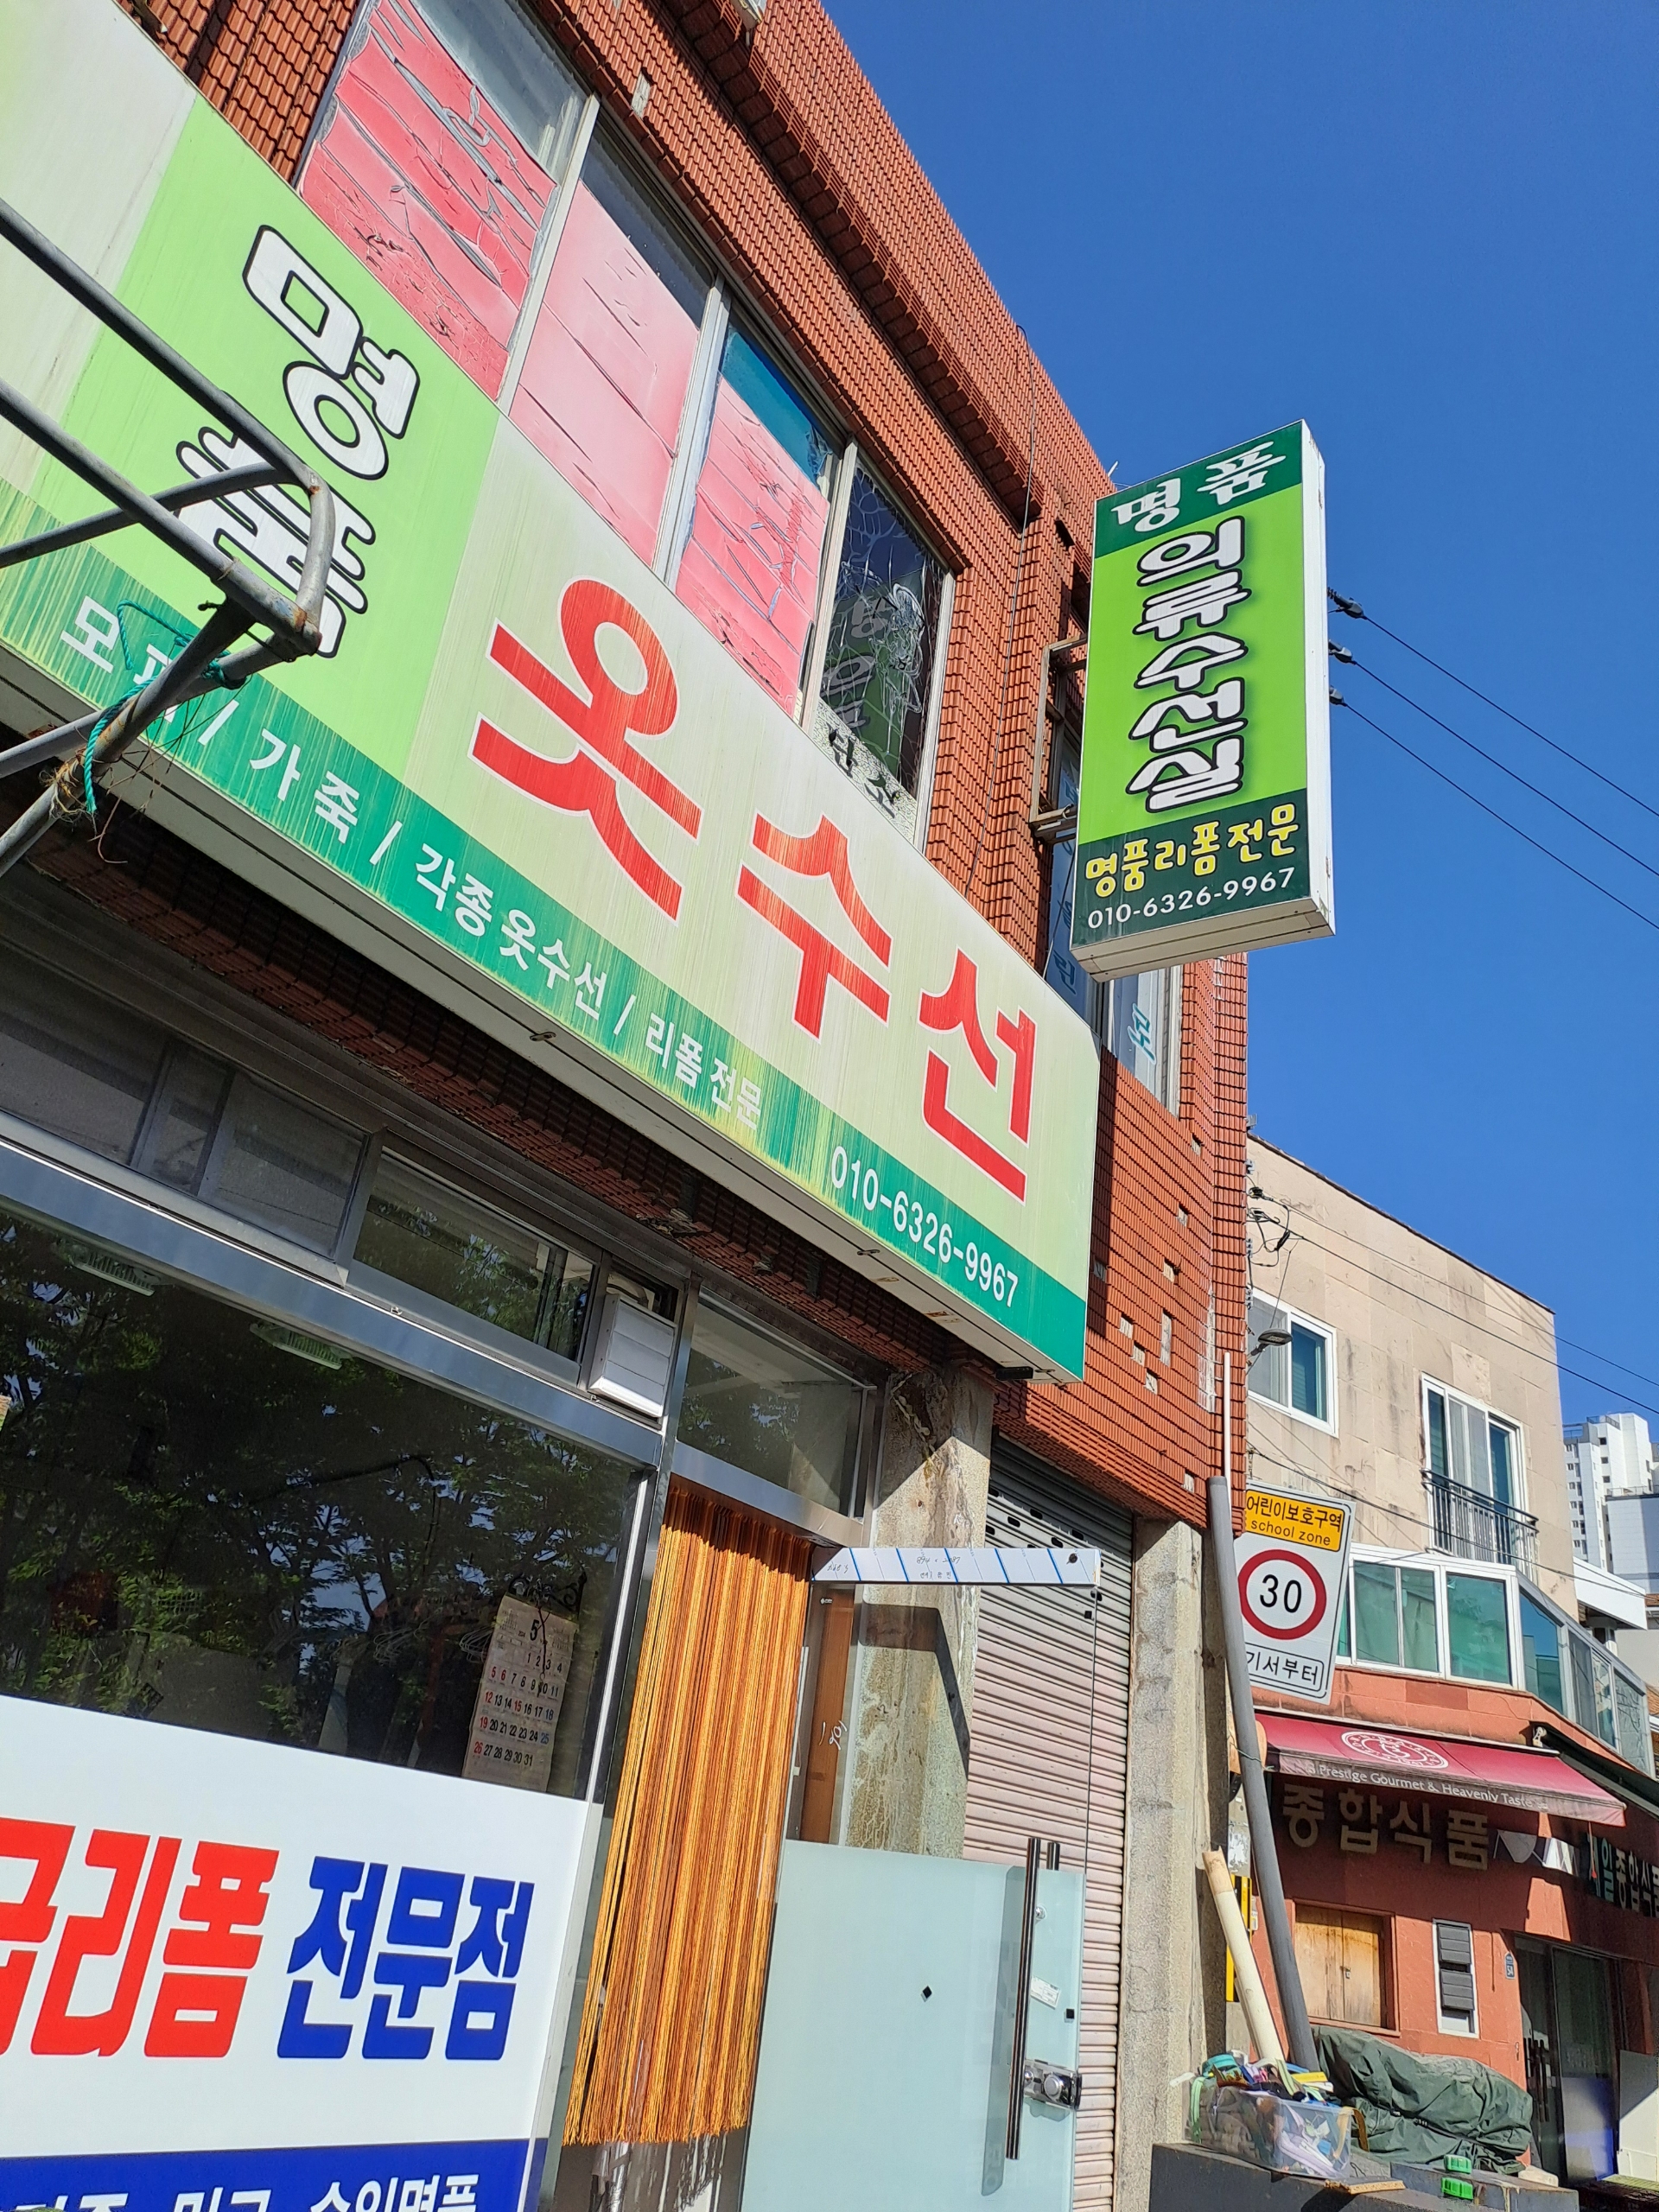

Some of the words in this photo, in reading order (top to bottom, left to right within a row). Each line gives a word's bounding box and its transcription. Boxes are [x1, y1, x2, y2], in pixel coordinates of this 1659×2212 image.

[1125, 514, 1252, 815] 의류수선실
[1087, 867, 1296, 930] 010-6326-9967
[830, 1145, 1020, 1308] 010-6326-9967
[1246, 1495, 1342, 1533] 어린이보호구역
[1250, 1519, 1295, 1538] school
[1299, 1530, 1332, 1546] zone
[1259, 1573, 1302, 1614] 30
[1319, 1764, 1368, 1783] Prestige
[1370, 1772, 1425, 1792] Gourmet
[1442, 1783, 1498, 1803] Heavenly
[1500, 1793, 1534, 1808] Taste
[1282, 1783, 1489, 1871] 종합식품
[276, 1855, 536, 2060] 전문점
